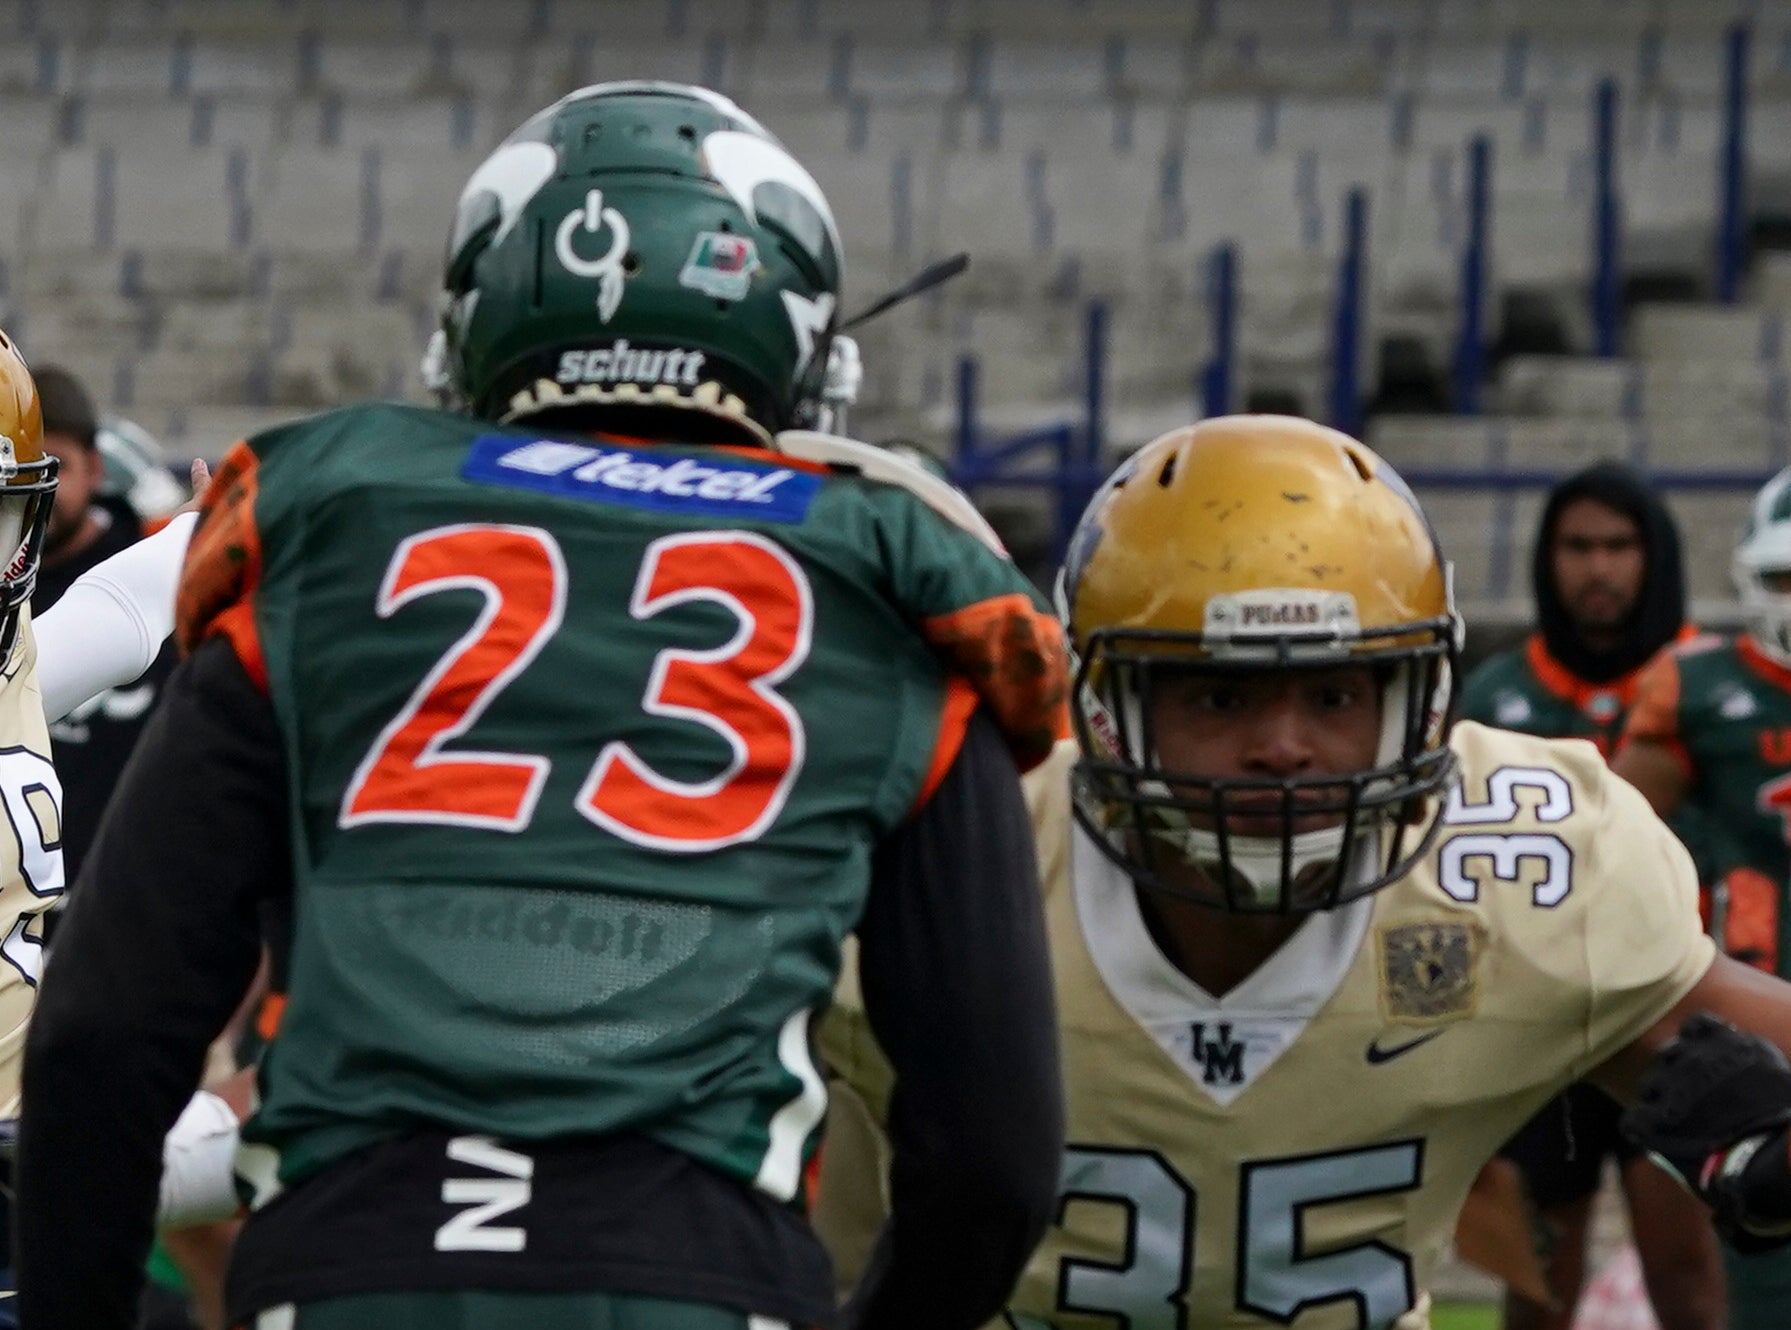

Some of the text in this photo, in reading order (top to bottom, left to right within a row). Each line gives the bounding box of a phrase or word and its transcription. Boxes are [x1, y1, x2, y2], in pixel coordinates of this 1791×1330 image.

[557, 338, 705, 385] schutt
[572, 452, 796, 503] telcel
[1241, 602, 1320, 627] PUMAS
[338, 522, 814, 852] 23
[1437, 764, 1575, 908] 35
